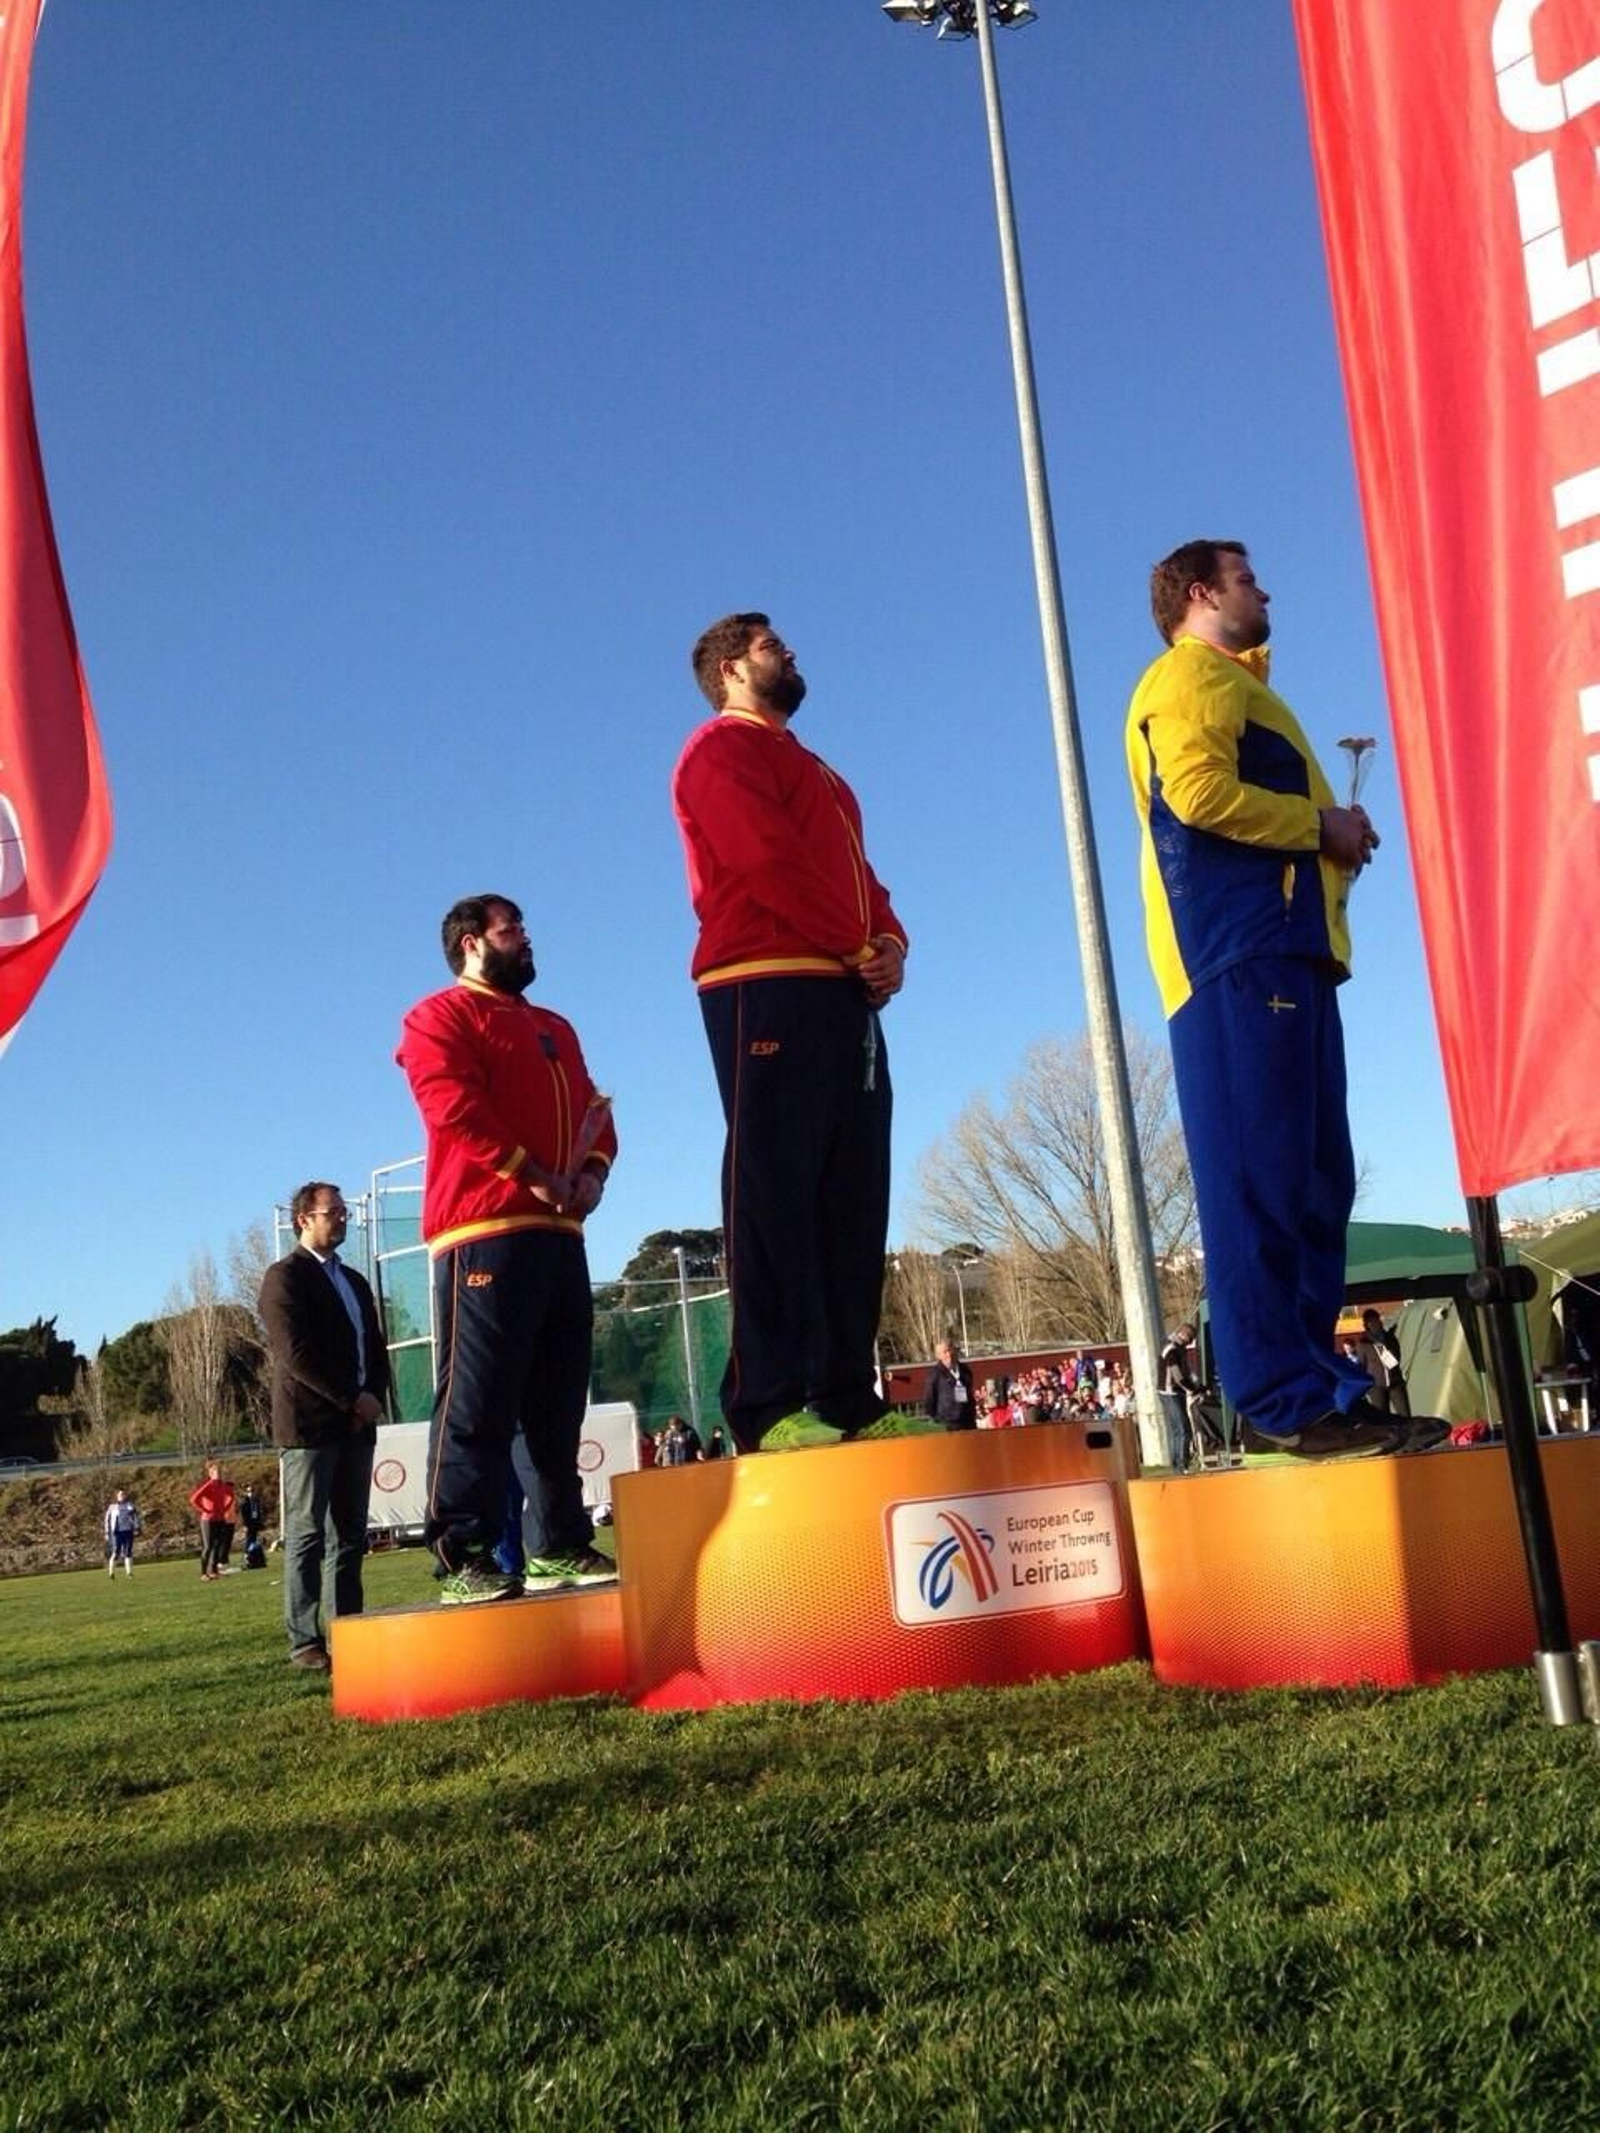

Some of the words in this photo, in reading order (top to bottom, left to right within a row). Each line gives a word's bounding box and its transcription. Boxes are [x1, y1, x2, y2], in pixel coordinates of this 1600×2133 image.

[750, 1042, 780, 1055] ESP
[467, 1273, 493, 1287] ESP
[1007, 1513, 1069, 1532] European
[1072, 1508, 1095, 1526] Cup
[1008, 1538, 1057, 1555] Winter
[1059, 1531, 1111, 1547] Throwing
